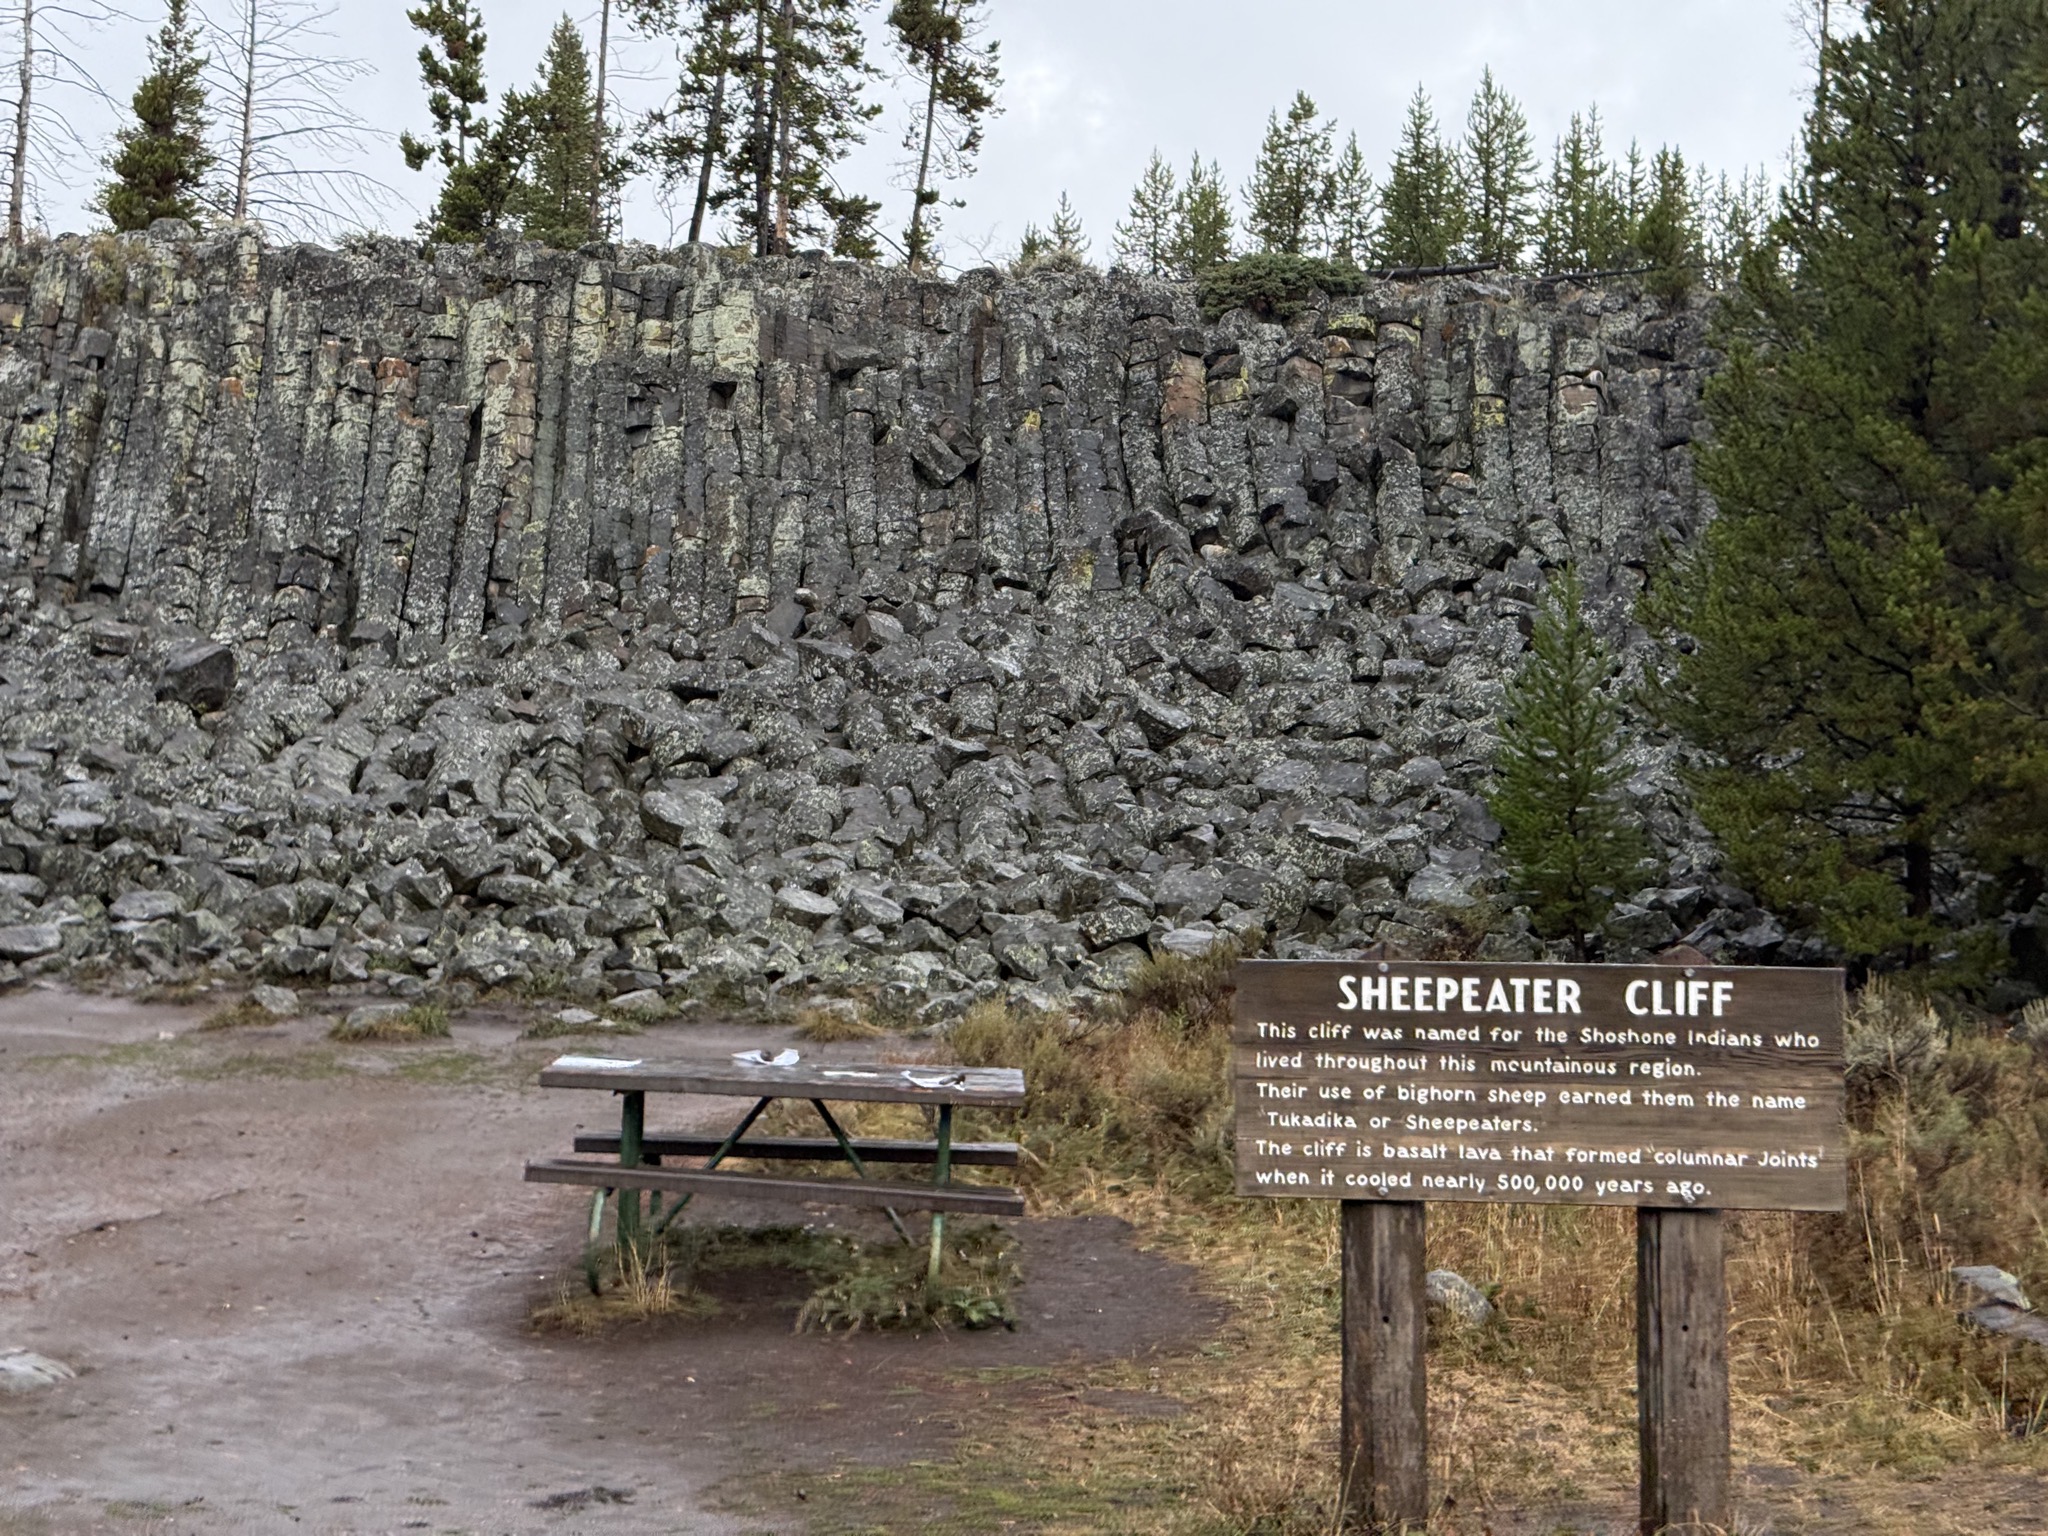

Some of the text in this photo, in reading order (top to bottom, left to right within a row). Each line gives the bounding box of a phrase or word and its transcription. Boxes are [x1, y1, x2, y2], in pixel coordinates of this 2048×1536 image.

[1337, 975, 1734, 1017] SHEEPEATER CLIFF
[1257, 1021, 1820, 1048] This cliff was named for the Shoshone Indians who
[1256, 1050, 1302, 1068] lived
[1315, 1053, 1428, 1074] throughout
[1439, 1054, 1476, 1072] this
[1629, 1057, 1701, 1079] region.
[1256, 1082, 1806, 1110] Their use of bighorn sheep earned them the name
[1369, 1116, 1391, 1129] or
[1405, 1114, 1538, 1135] Sheepeaters.
[1255, 1139, 1293, 1156] The
[1303, 1138, 1347, 1157] cliff
[1356, 1140, 1372, 1158] is
[1383, 1142, 1448, 1160] basalt
[1458, 1143, 1502, 1162] lava
[1512, 1145, 1555, 1163] that
[1565, 1147, 1642, 1164] formed
[1255, 1168, 1713, 1202] when it cooled nearly 500,000 years ago.
